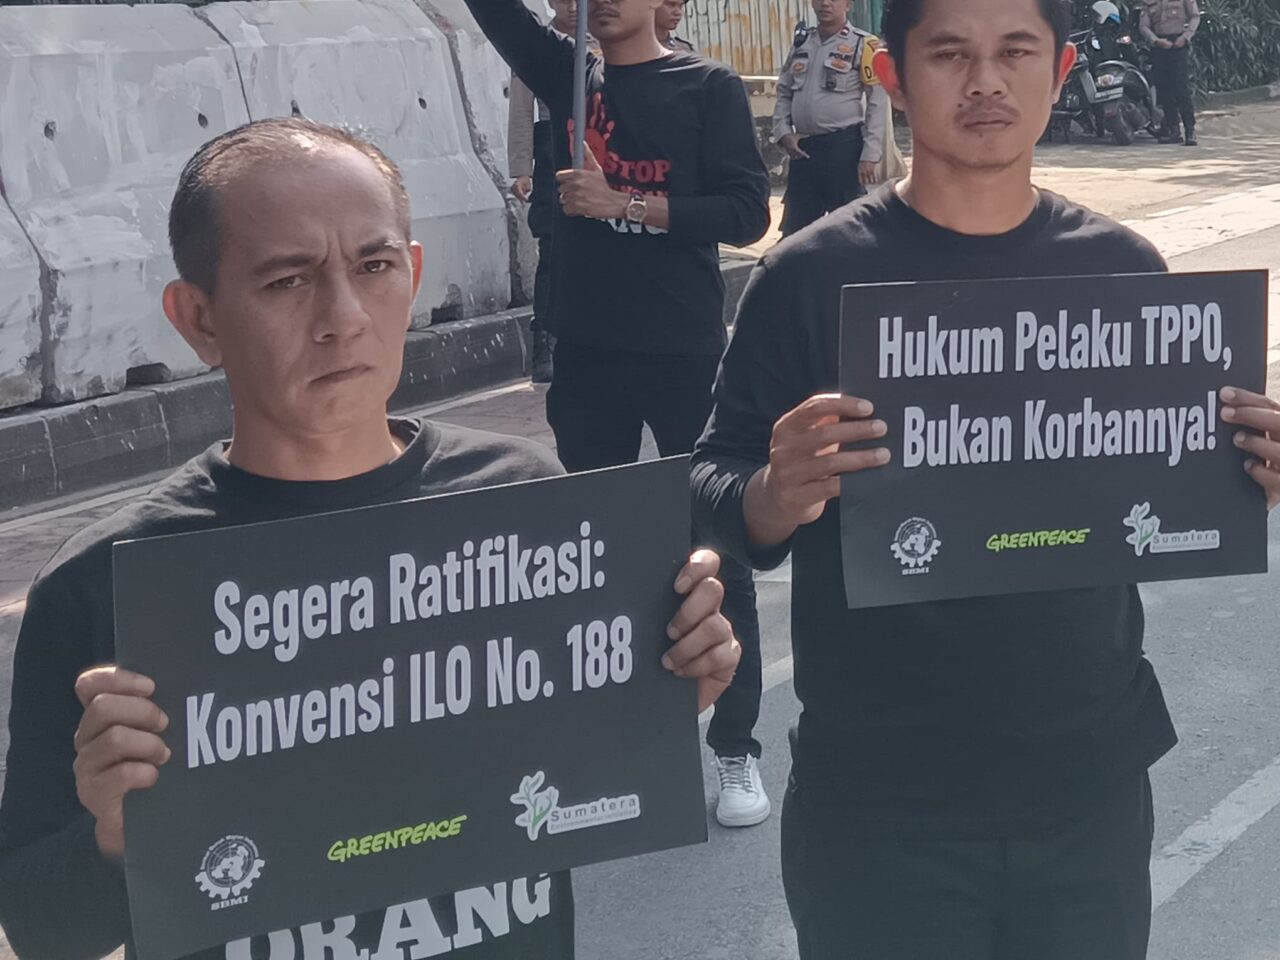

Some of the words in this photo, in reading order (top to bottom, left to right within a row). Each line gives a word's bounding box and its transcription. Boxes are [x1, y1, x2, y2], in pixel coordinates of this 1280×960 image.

[603, 151, 672, 183] STOP
[878, 315, 1004, 379] Hukum
[1014, 308, 1132, 372] Pelaku
[1141, 301, 1232, 370] TPPO,
[903, 404, 1012, 468] Bukan
[1024, 390, 1217, 467] Korbannya!
[986, 528, 1091, 552] GREENPEACE
[1152, 533, 1217, 545] Sumatera
[213, 575, 374, 663] Segera
[389, 521, 606, 625] Ratifikasi:
[186, 657, 395, 769] Konvensi
[410, 644, 471, 724] ILO
[487, 637, 554, 709] No.
[566, 616, 634, 692] 188
[551, 798, 637, 823] Sumatera
[327, 814, 467, 863] GREENPEACE
